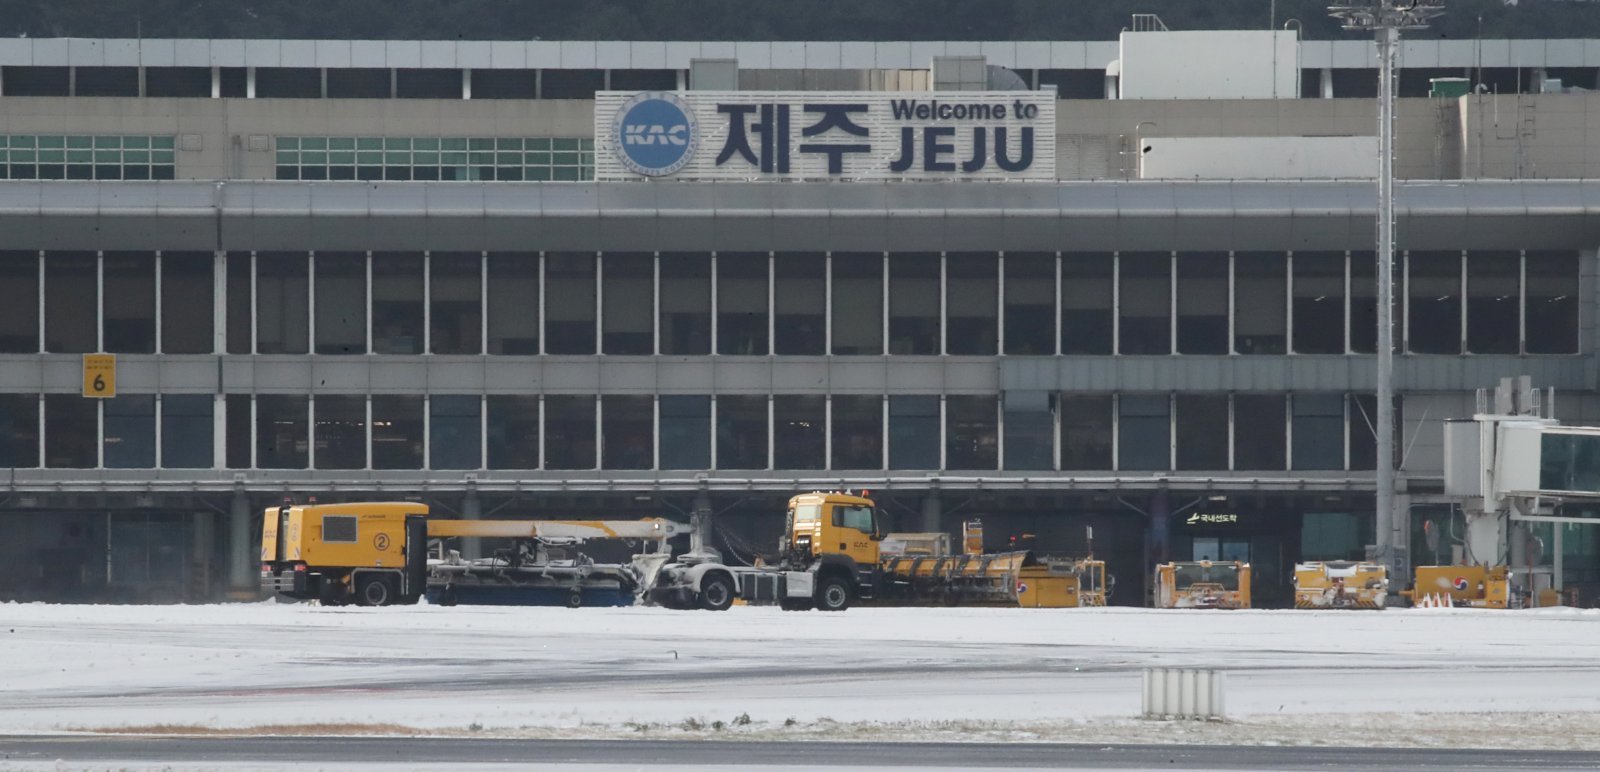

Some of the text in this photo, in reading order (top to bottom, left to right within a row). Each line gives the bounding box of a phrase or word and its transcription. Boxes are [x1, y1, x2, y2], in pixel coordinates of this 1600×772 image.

[890, 99, 1038, 120] Welcome to
[625, 124, 686, 146] KAC
[715, 103, 871, 174] 제주
[890, 126, 1034, 172] JEJU
[93, 373, 105, 392] 6
